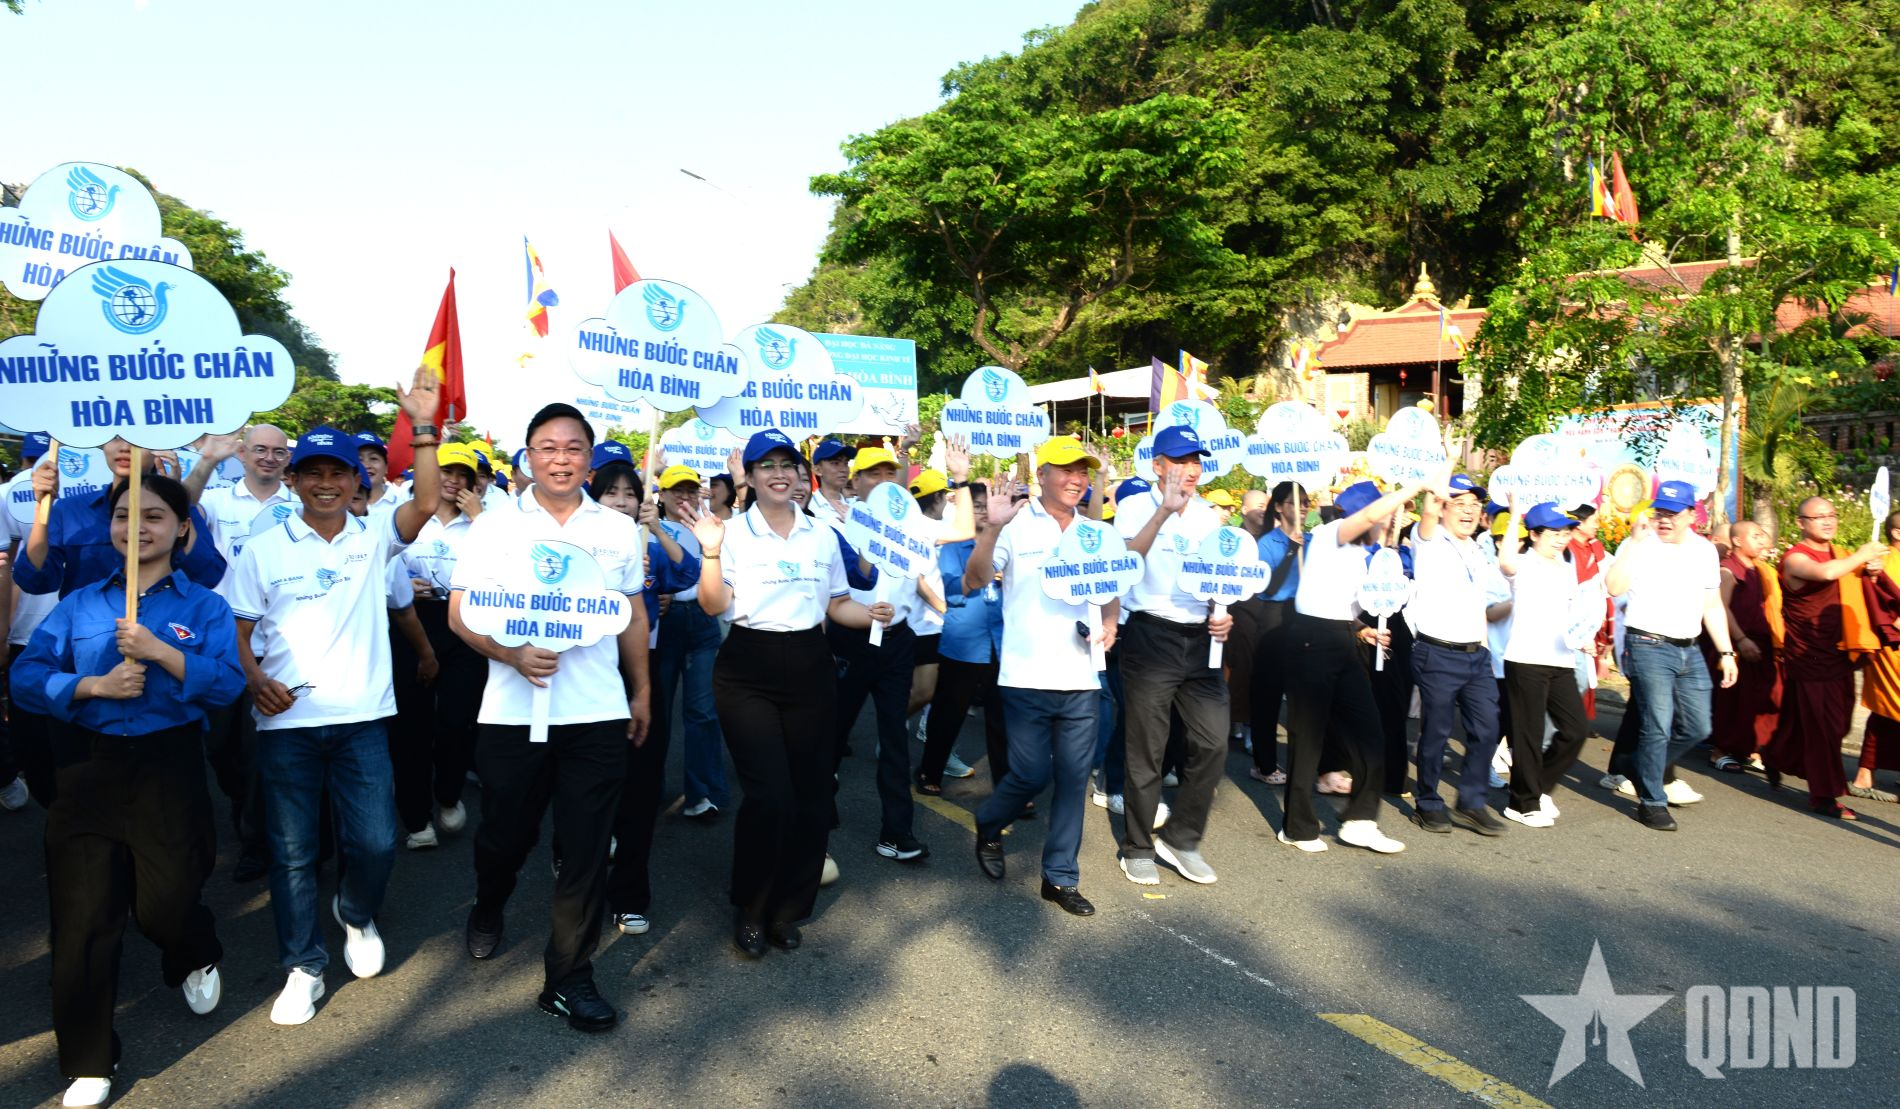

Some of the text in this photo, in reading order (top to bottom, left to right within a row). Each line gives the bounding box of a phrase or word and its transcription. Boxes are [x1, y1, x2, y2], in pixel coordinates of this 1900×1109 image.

[0, 215, 54, 251] HỮNG
[58, 227, 114, 261] BƯỚC
[0, 340, 275, 384] NHỮNG BƯỚC CHÂN
[578, 325, 738, 375] NHỮNG BƯỚC CHÂN
[618, 368, 700, 400] HÒA BÌNH
[762, 373, 803, 400] BƯỚC
[808, 380, 852, 401] CHÂN
[880, 370, 912, 386] BÌNH
[71, 394, 214, 427] HÒA BÌNH
[740, 406, 818, 428] HÒA BÌNH
[945, 403, 1043, 428] NHỮNG BƯỚC CHÂN
[664, 440, 694, 455] NHỮNG
[971, 429, 1021, 448] HÒA BÌNH
[1210, 434, 1240, 451] CHÂN
[703, 459, 724, 470] BÌNH
[1044, 555, 1137, 579] NHỮNG BƯỚC CHÂN
[1181, 556, 1265, 580] NHỮNG BƯỚC CHÂN
[469, 584, 620, 615] NHỮNG BƯỚC CHÂN
[1070, 579, 1118, 597] HÒA BÌNH
[1200, 580, 1242, 596] HÒA BÌNH
[505, 616, 583, 640] HÒA BÌNH
